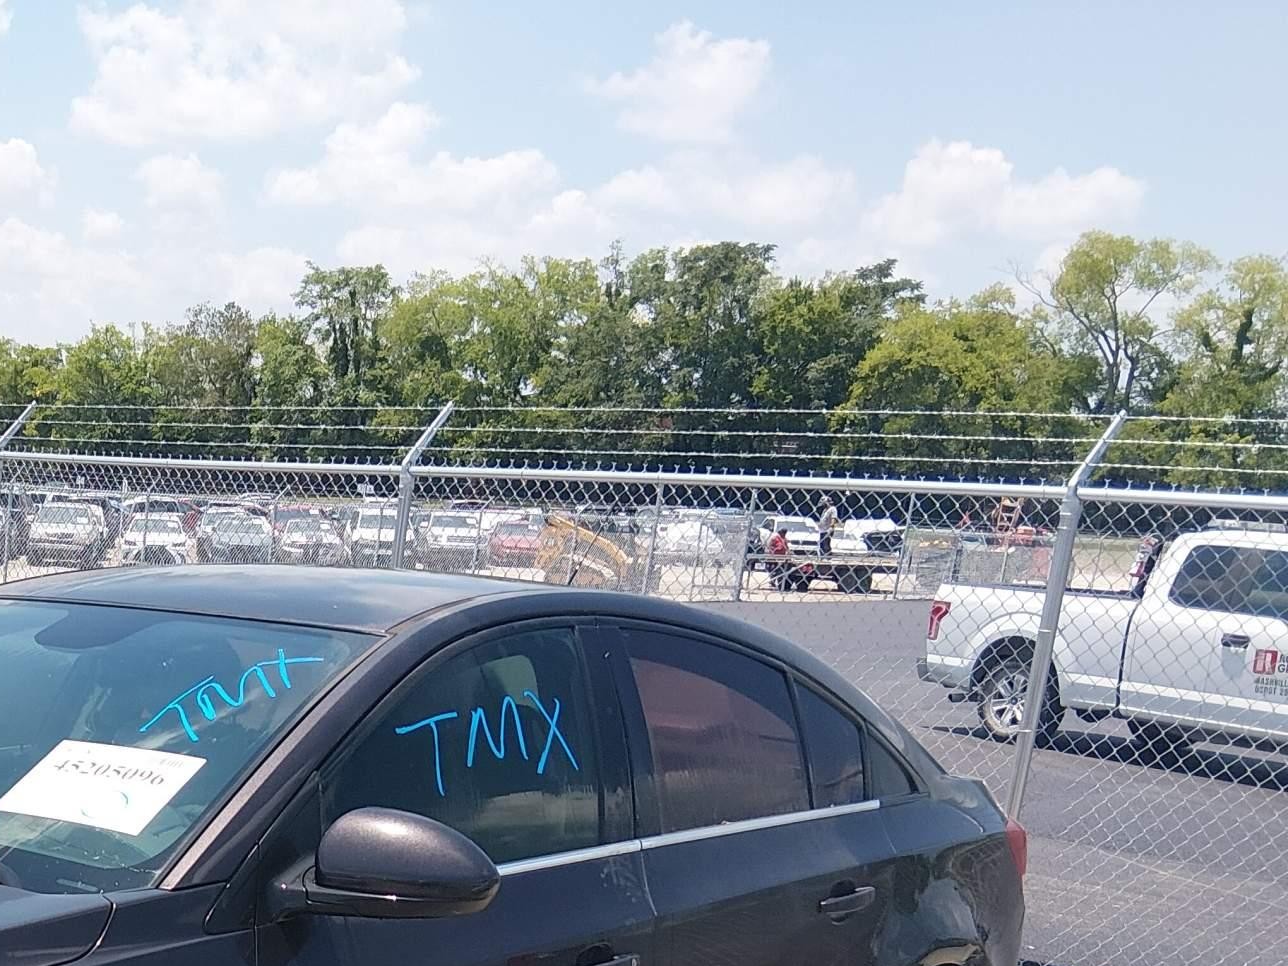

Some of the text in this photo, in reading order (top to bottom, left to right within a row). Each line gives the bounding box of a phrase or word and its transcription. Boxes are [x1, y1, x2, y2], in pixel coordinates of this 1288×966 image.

[139, 648, 324, 742] TMX
[52, 759, 165, 786] 45205096
[395, 688, 579, 797] TMX
